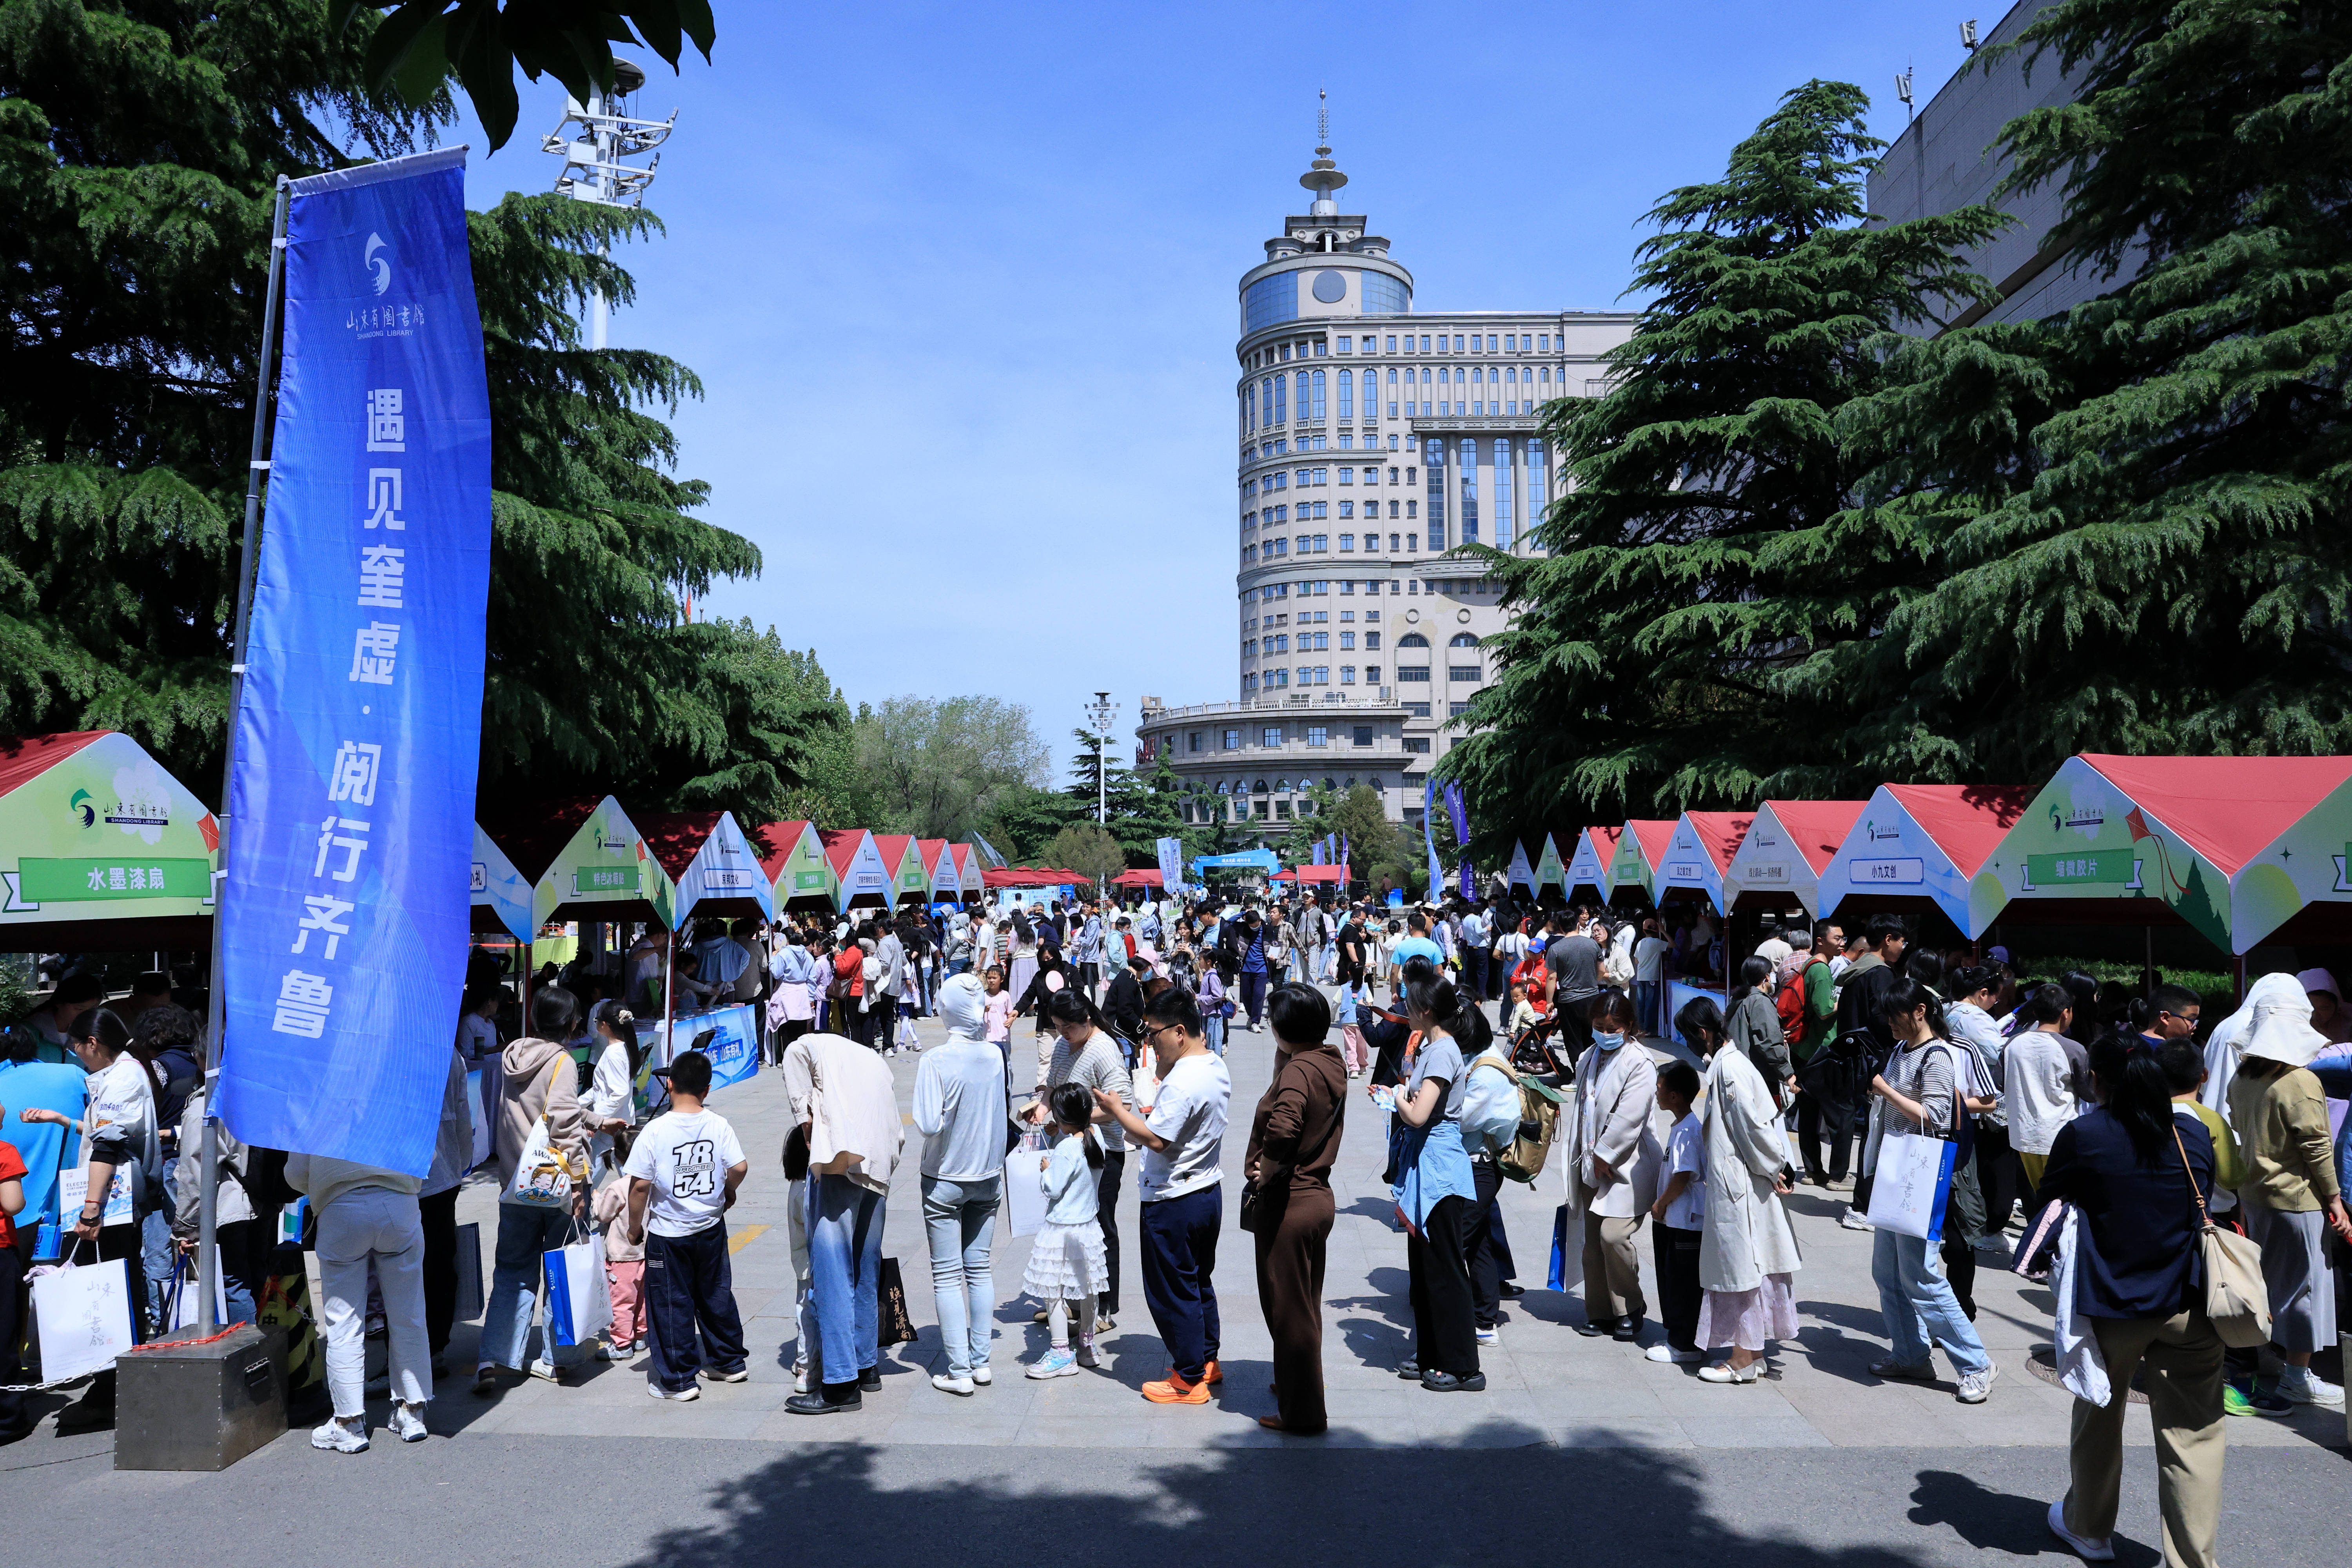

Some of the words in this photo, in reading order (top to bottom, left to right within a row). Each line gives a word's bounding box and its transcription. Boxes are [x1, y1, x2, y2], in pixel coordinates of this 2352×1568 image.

[357, 330, 383, 339] SHANDONG
[1872, 864, 1896, 878] 小九文创
[2056, 858, 2098, 877] 缩微胶片
[87, 867, 165, 891] 水墨漆扇
[594, 872, 624, 886] 特色冰箱贴
[720, 1042, 742, 1062] 山东有礼
[673, 1140, 714, 1166] 18
[673, 1172, 715, 1199] 54
